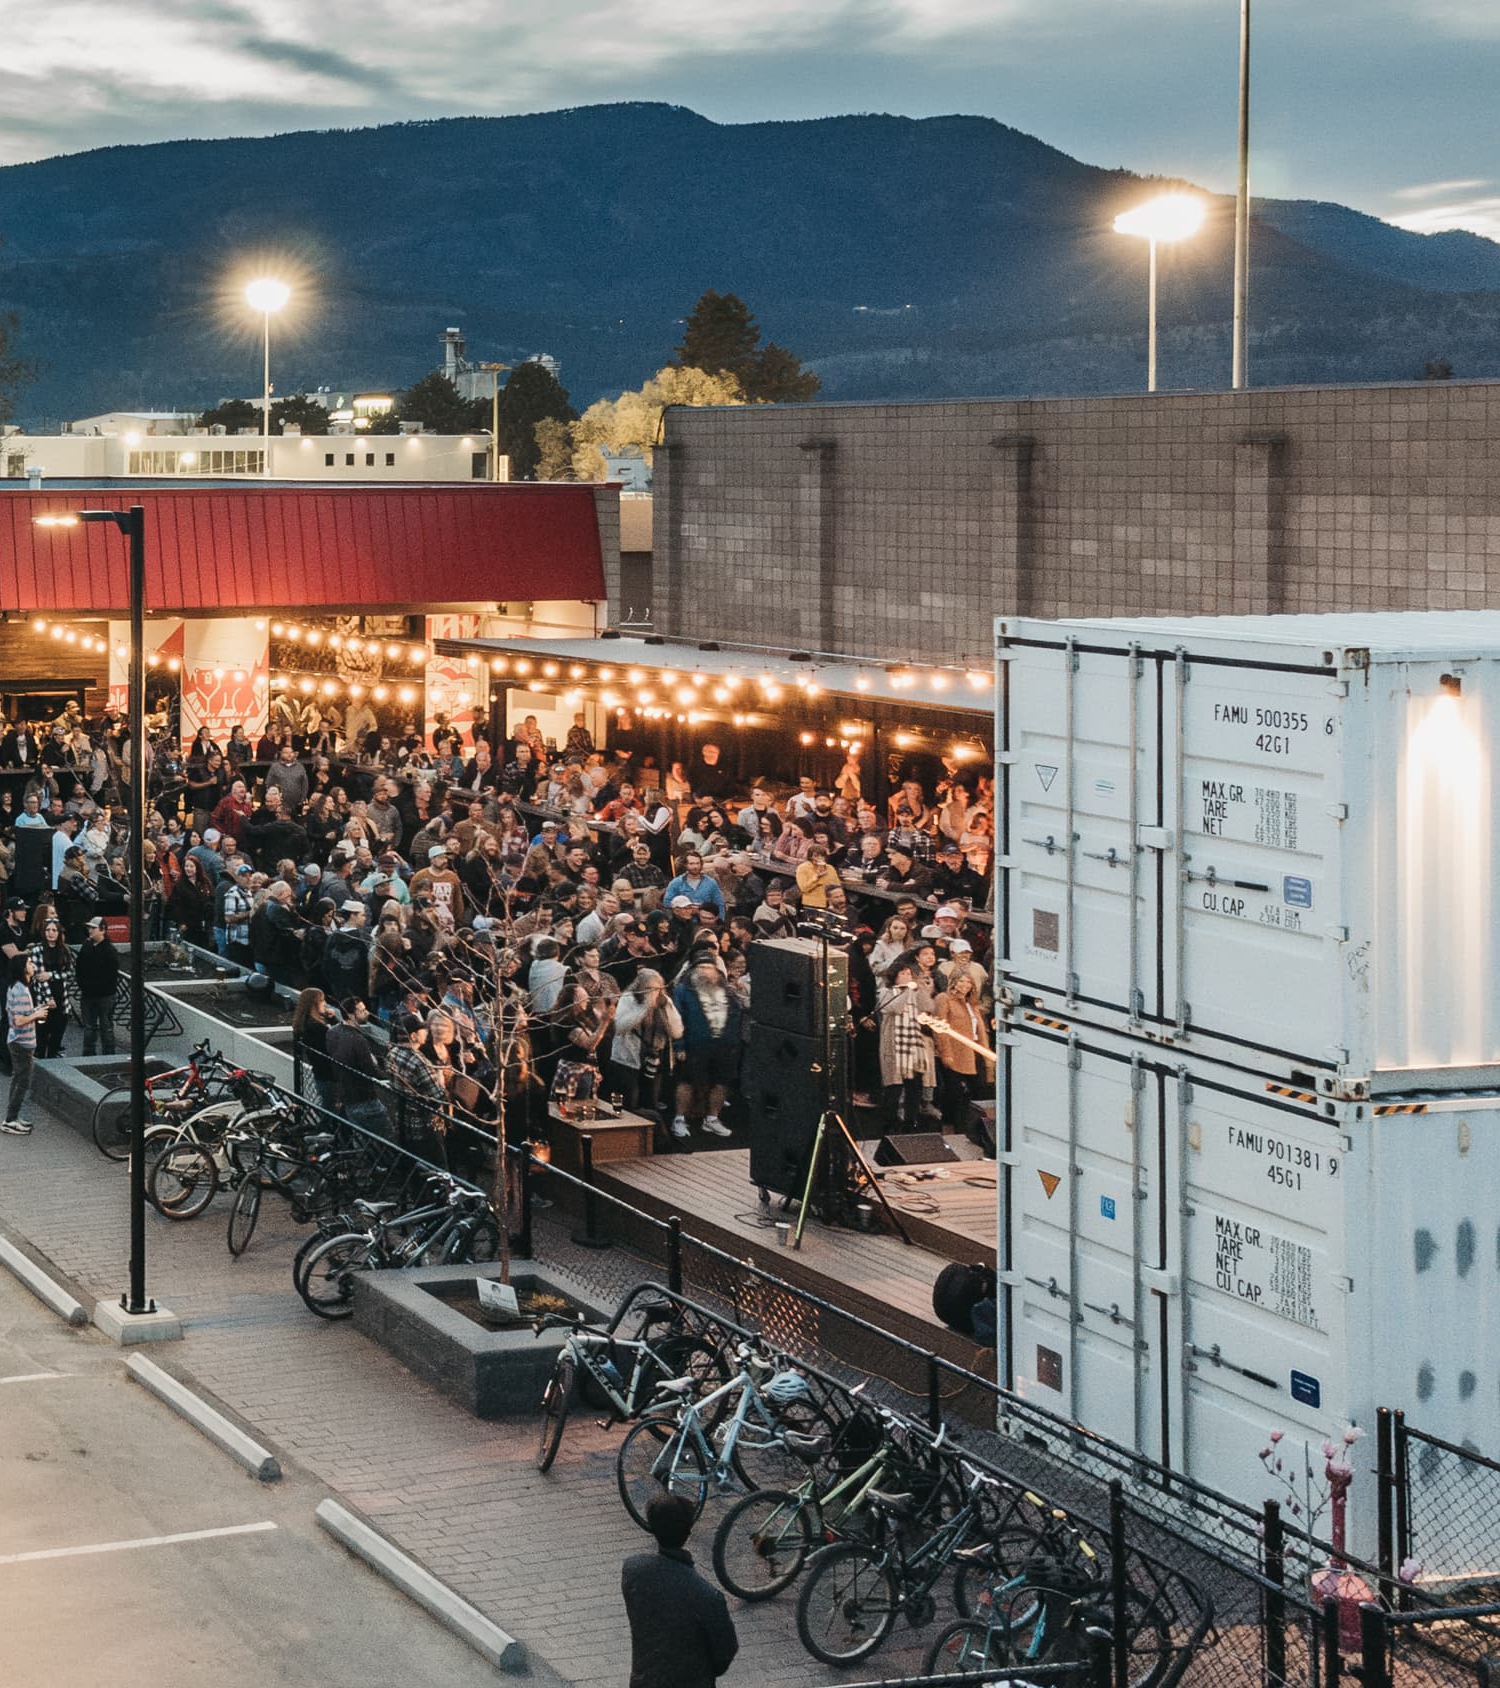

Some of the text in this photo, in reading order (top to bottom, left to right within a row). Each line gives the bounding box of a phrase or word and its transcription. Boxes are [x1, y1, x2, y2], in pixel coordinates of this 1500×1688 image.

[1214, 703, 1333, 735] FAMU 500355 6
[1255, 733, 1290, 754] 42G1
[1203, 798, 1228, 819] TARE
[1202, 816, 1223, 836] NET
[1222, 895, 1247, 918] CAP.
[1228, 1126, 1338, 1176] FAMU 901381 9
[1267, 1165, 1301, 1191] 45G1
[1216, 1234, 1243, 1260] TARE
[1215, 1252, 1238, 1276] NET
[1237, 1279, 1265, 1306] CAP.
